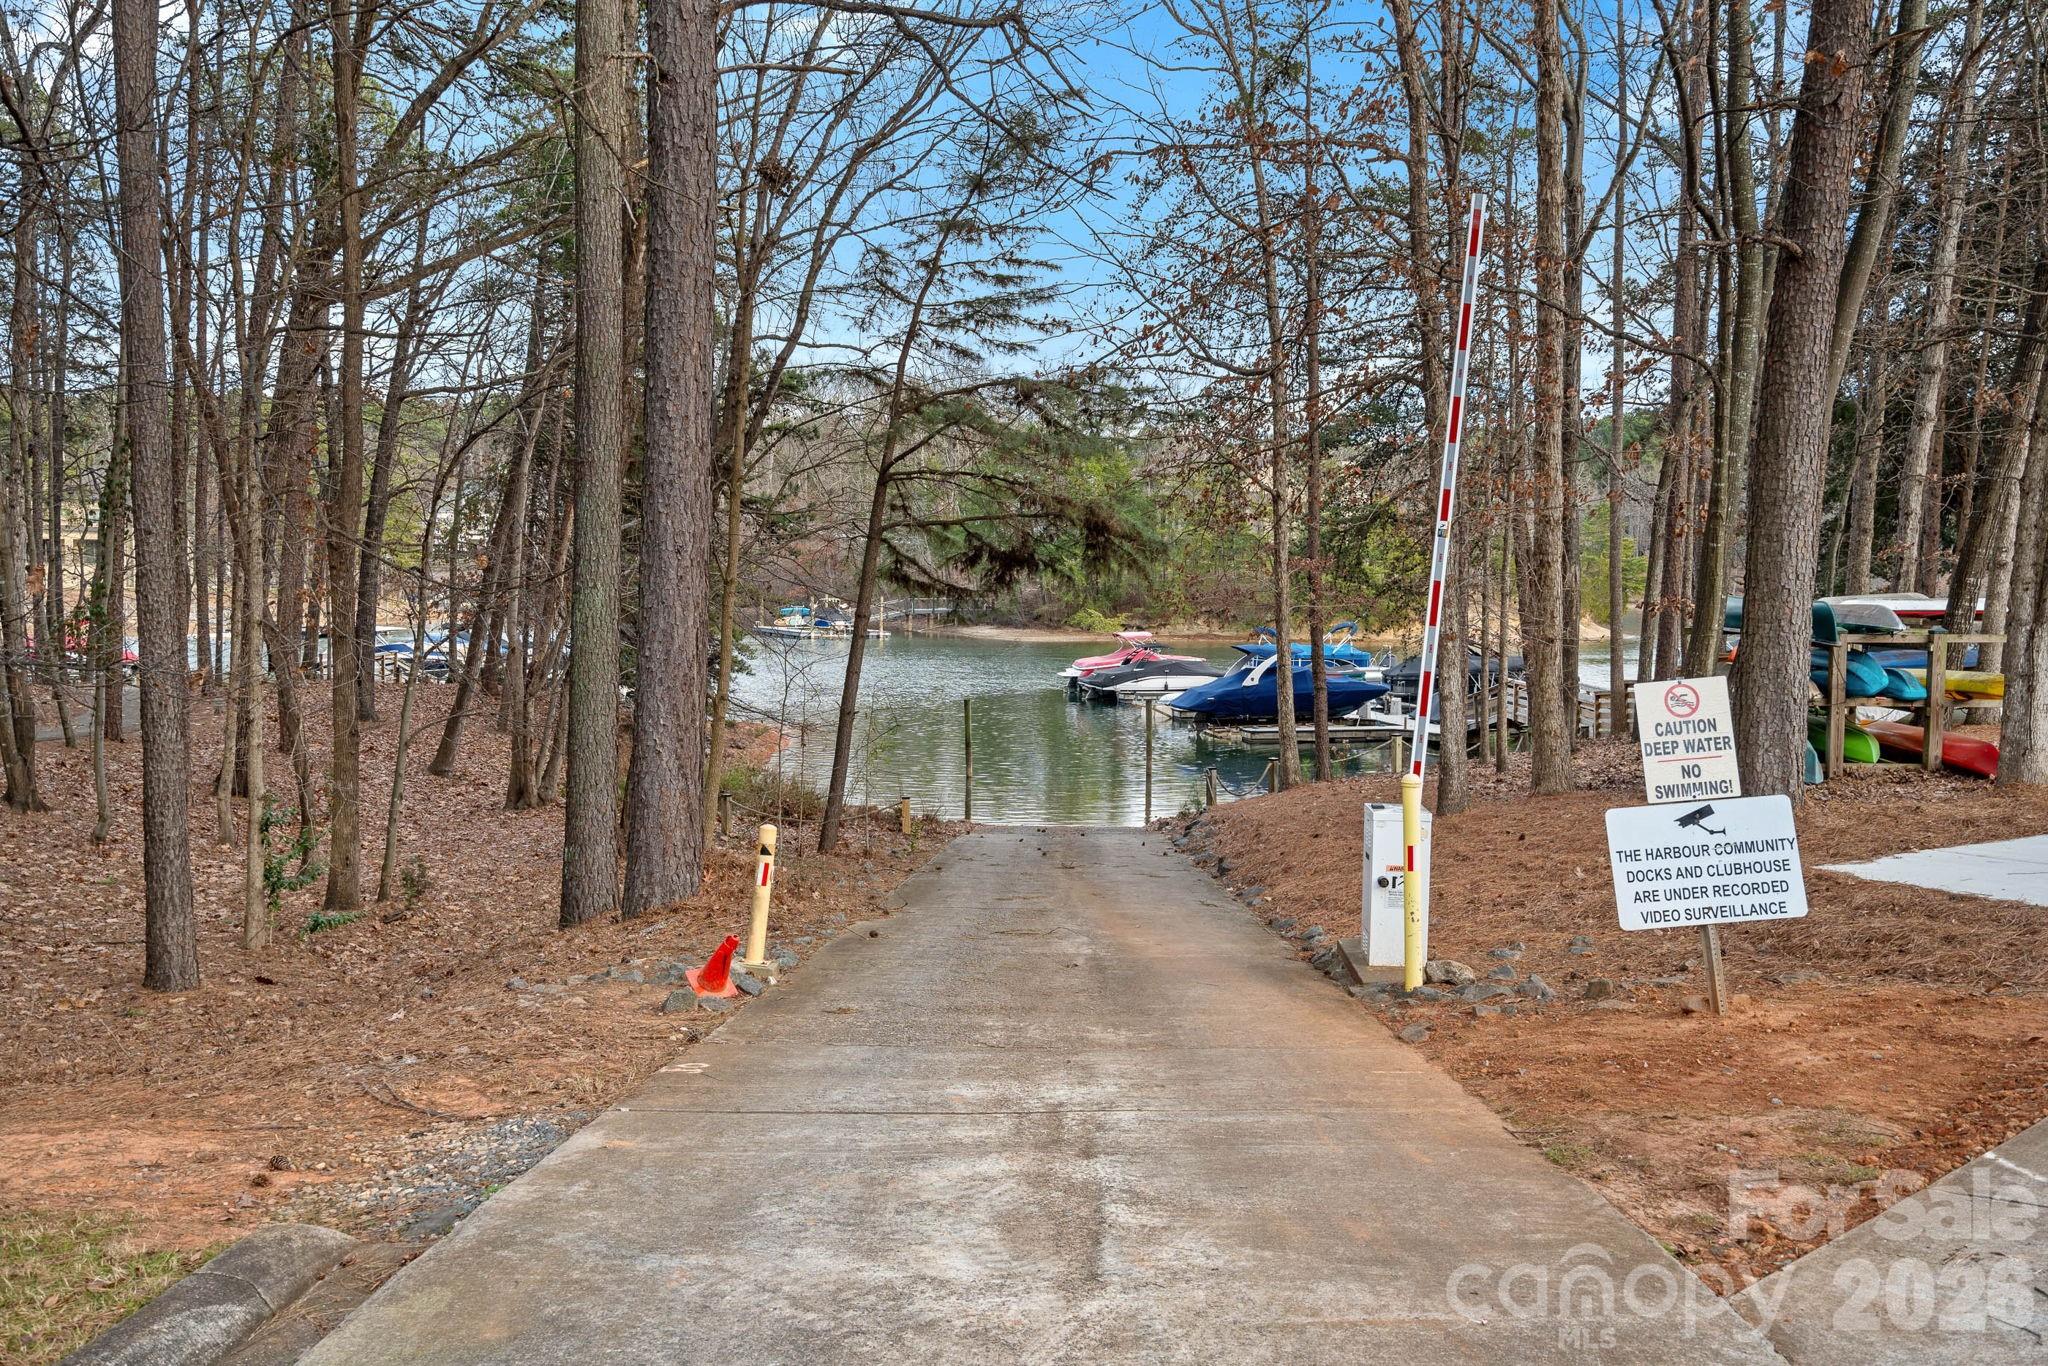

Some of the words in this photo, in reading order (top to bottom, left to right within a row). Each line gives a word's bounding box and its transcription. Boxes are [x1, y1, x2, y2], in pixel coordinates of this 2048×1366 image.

[1655, 718, 1717, 737] CAUTION
[1644, 741, 1679, 757] DEEP
[1683, 736, 1732, 754] WATER
[1681, 764, 1702, 779] NO
[1655, 780, 1733, 799] SWIMMING!
[1616, 849, 1642, 863] THE
[1645, 844, 1711, 862] HARBOUR
[1714, 838, 1795, 855] COMMUNITY
[1626, 868, 1672, 883] DOCKS
[1676, 866, 1702, 880] AND
[1706, 859, 1791, 877] CLUBHOUSE
[1634, 890, 1660, 904] ARE
[1664, 886, 1709, 901] UNDER
[1713, 880, 1789, 898] RECORDED
[1641, 909, 1681, 924] VIDEO
[1684, 901, 1788, 921] SURVEILLANCE
